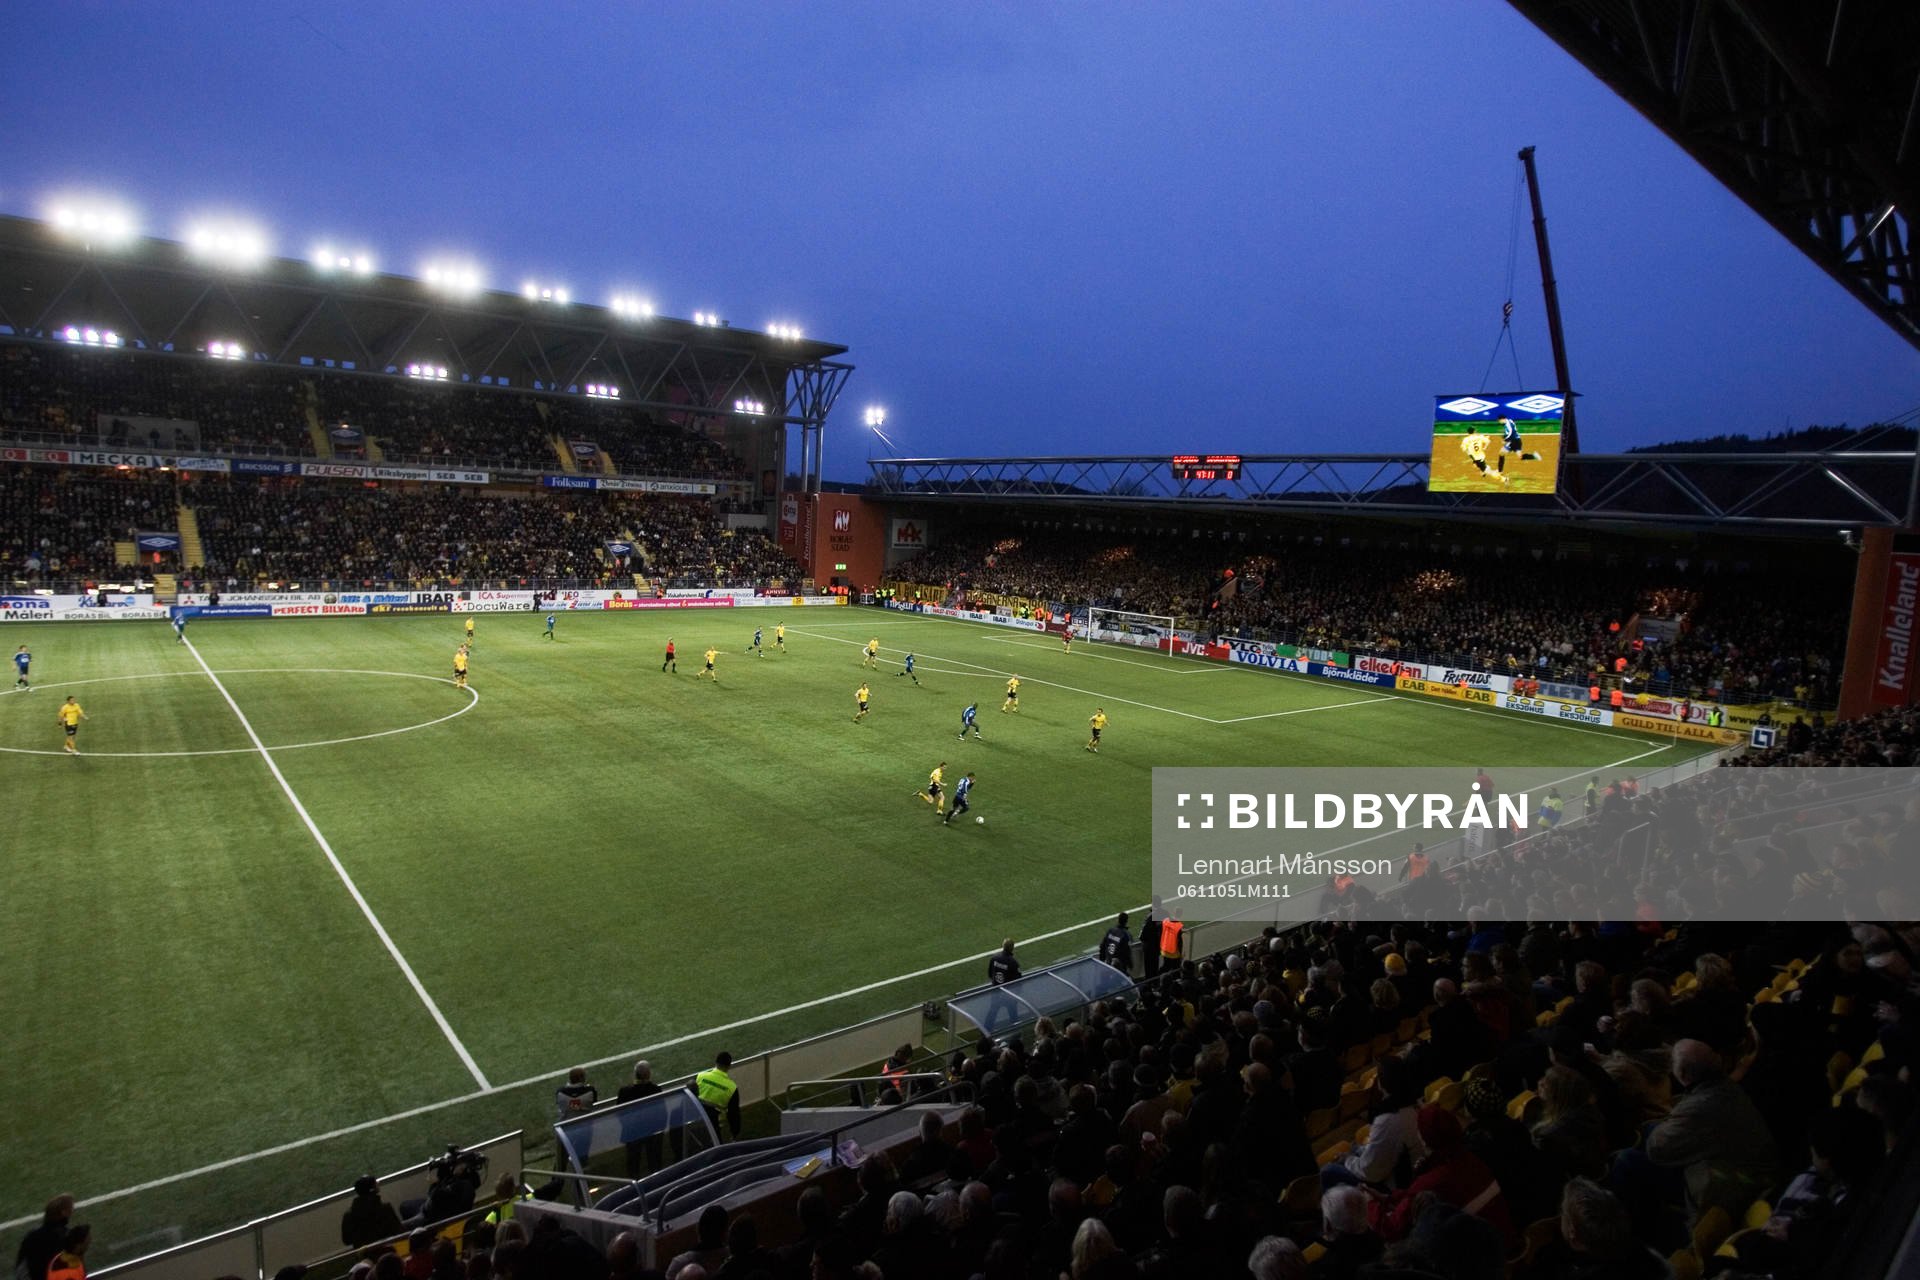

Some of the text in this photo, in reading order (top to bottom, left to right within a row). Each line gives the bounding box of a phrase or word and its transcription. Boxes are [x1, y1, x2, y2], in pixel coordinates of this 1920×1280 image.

[80, 454, 147, 466] MECKA
[239, 463, 280, 472] ERICSSON
[305, 465, 365, 477] PULSEN
[379, 469, 427, 479] Riksbyggen
[552, 476, 591, 488] Folksam
[274, 605, 320, 615] PERFECT
[467, 602, 530, 612] DocuWare
[1182, 642, 1206, 656] JVC
[1236, 651, 1299, 672] VOLVIA
[1322, 666, 1379, 685] Björnkläder
[1443, 670, 1492, 685] FRISTADS
[1402, 679, 1425, 691] EAB
[1465, 690, 1490, 702] EAB
[1621, 718, 1654, 730] GULD
[1683, 728, 1714, 740] ALLA
